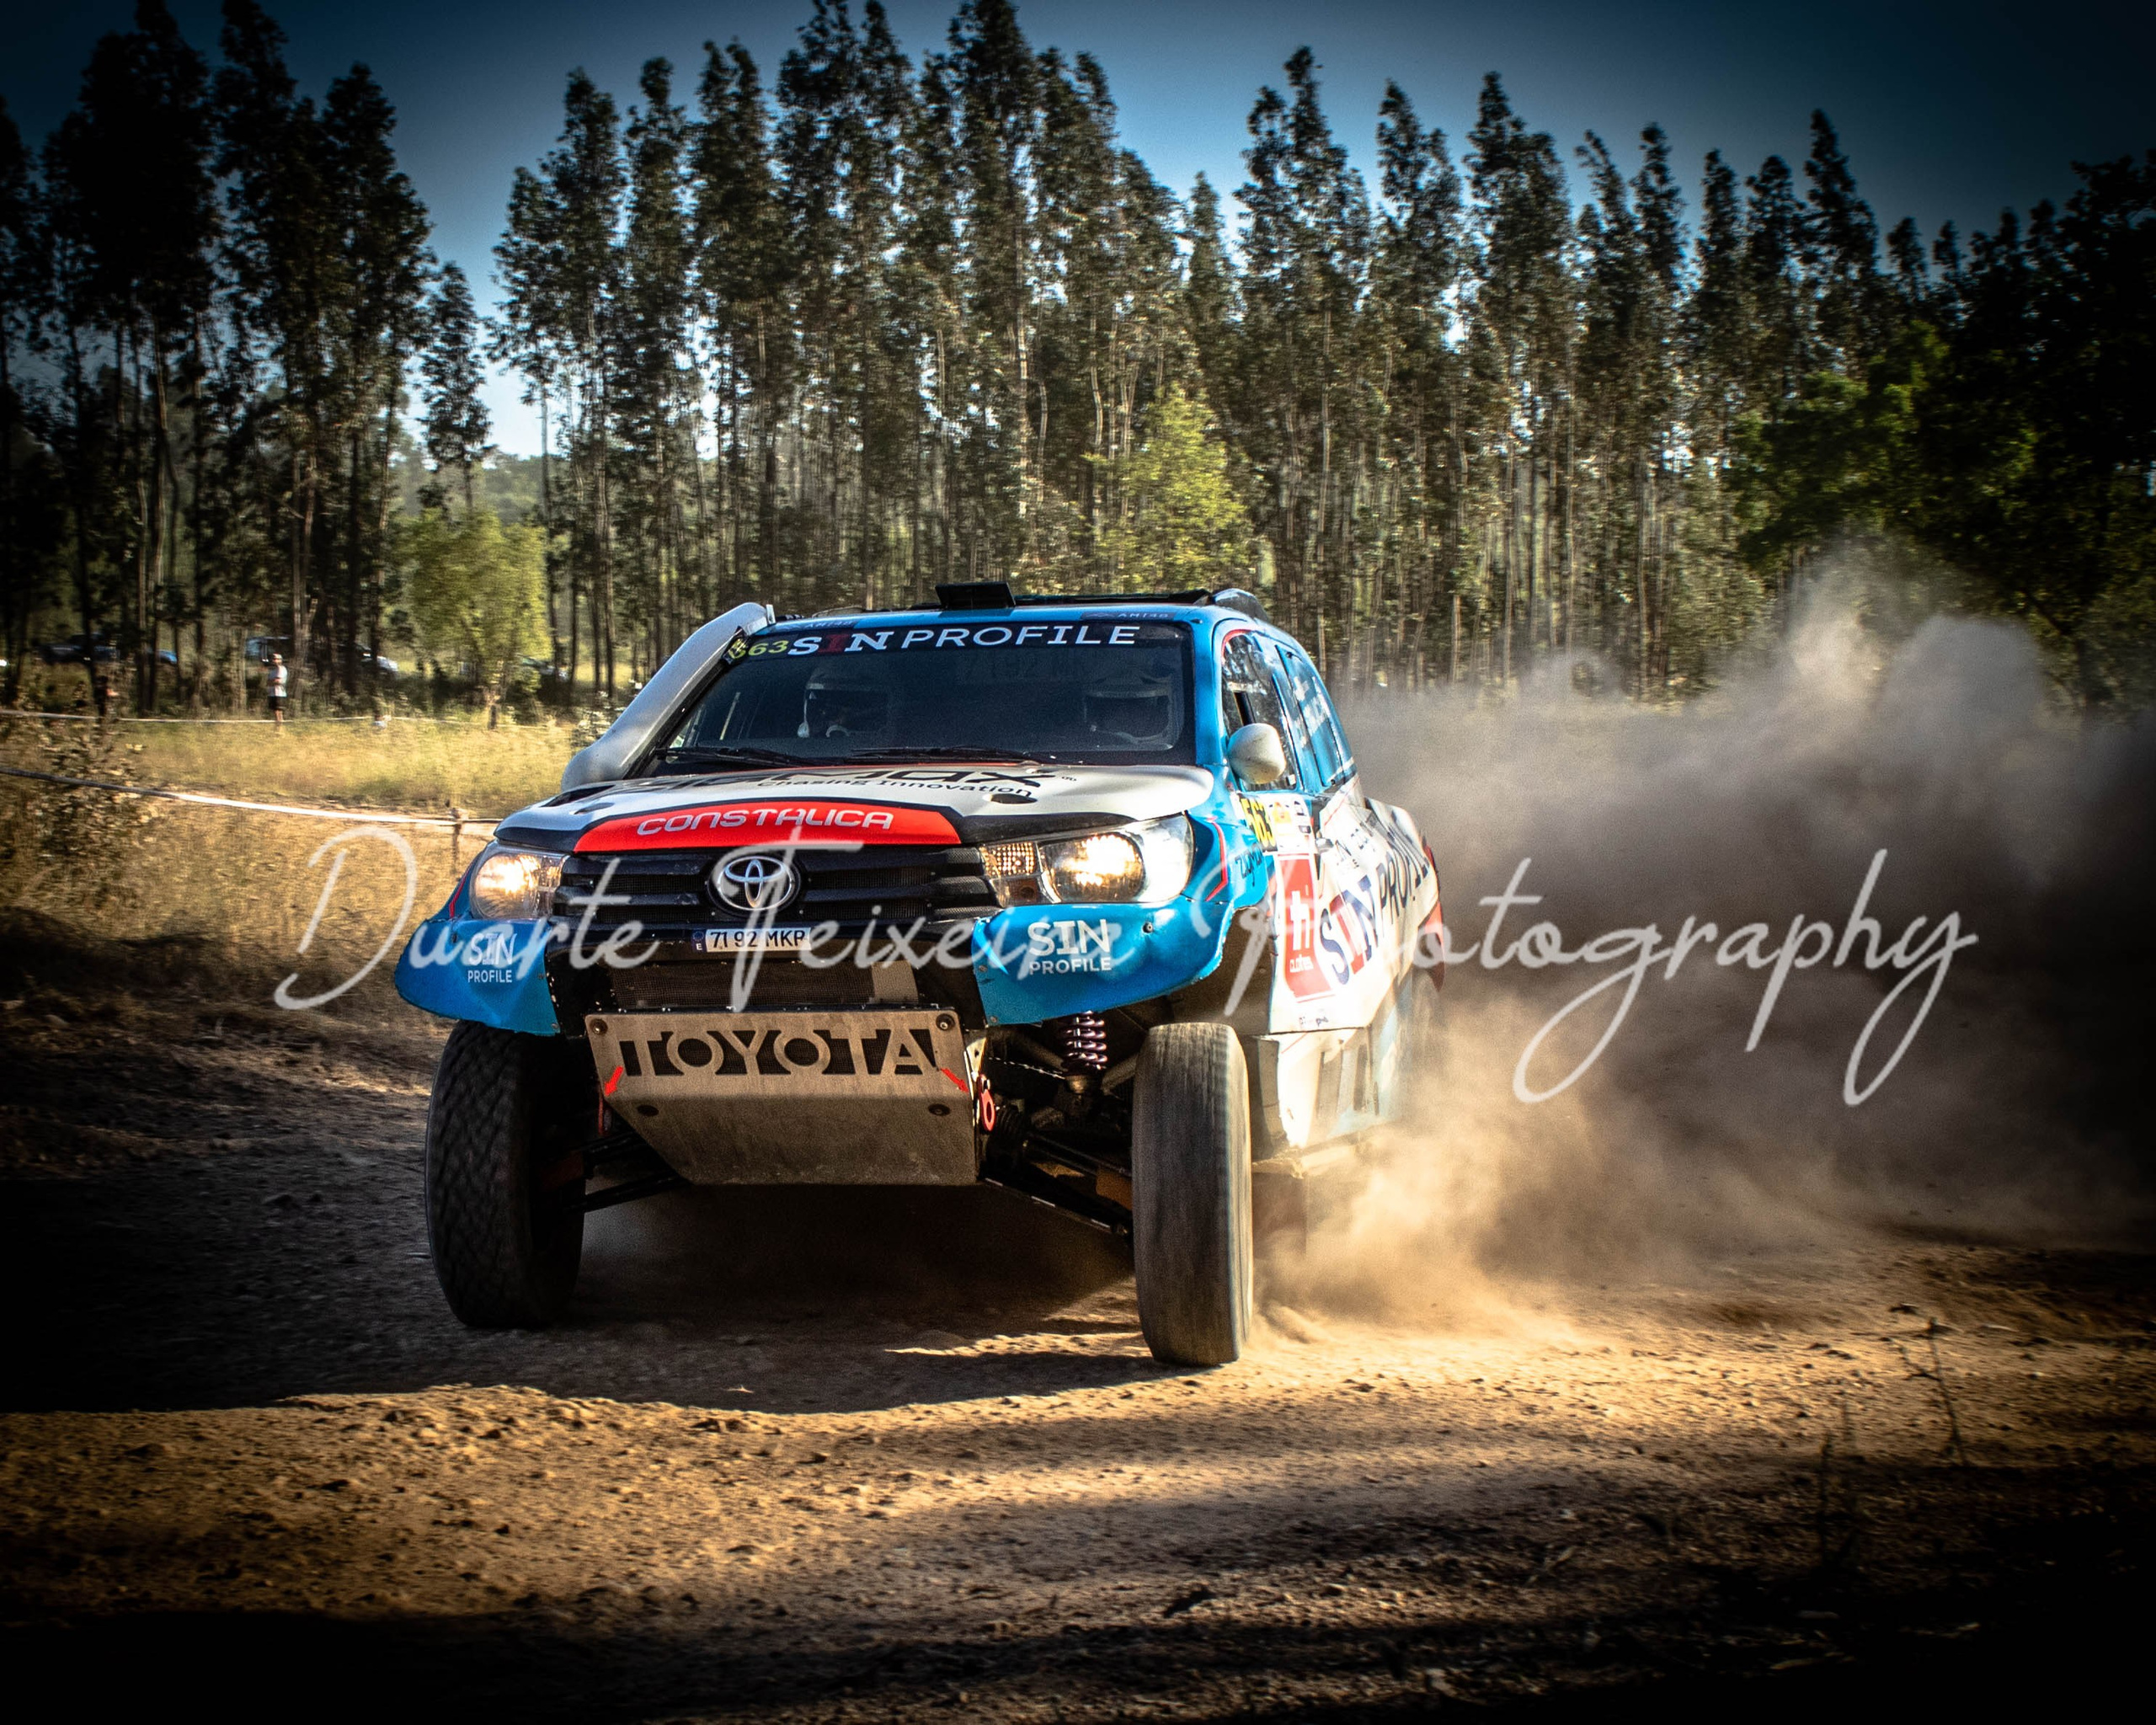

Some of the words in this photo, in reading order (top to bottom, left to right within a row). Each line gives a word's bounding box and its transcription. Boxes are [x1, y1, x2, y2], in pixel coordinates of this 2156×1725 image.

[787, 632, 894, 655] SIN
[900, 625, 1140, 649] PROFILE
[758, 778, 867, 787] Chasing
[877, 780, 1033, 798] Innovation
[637, 808, 894, 836] CONSTALICA
[1027, 918, 1110, 957] SIN
[1320, 873, 1380, 985] SIN
[469, 932, 517, 966] SIN
[467, 969, 513, 984] PROFILE
[1028, 956, 1112, 975] PROFILE
[619, 1028, 940, 1076] TOYOTA
